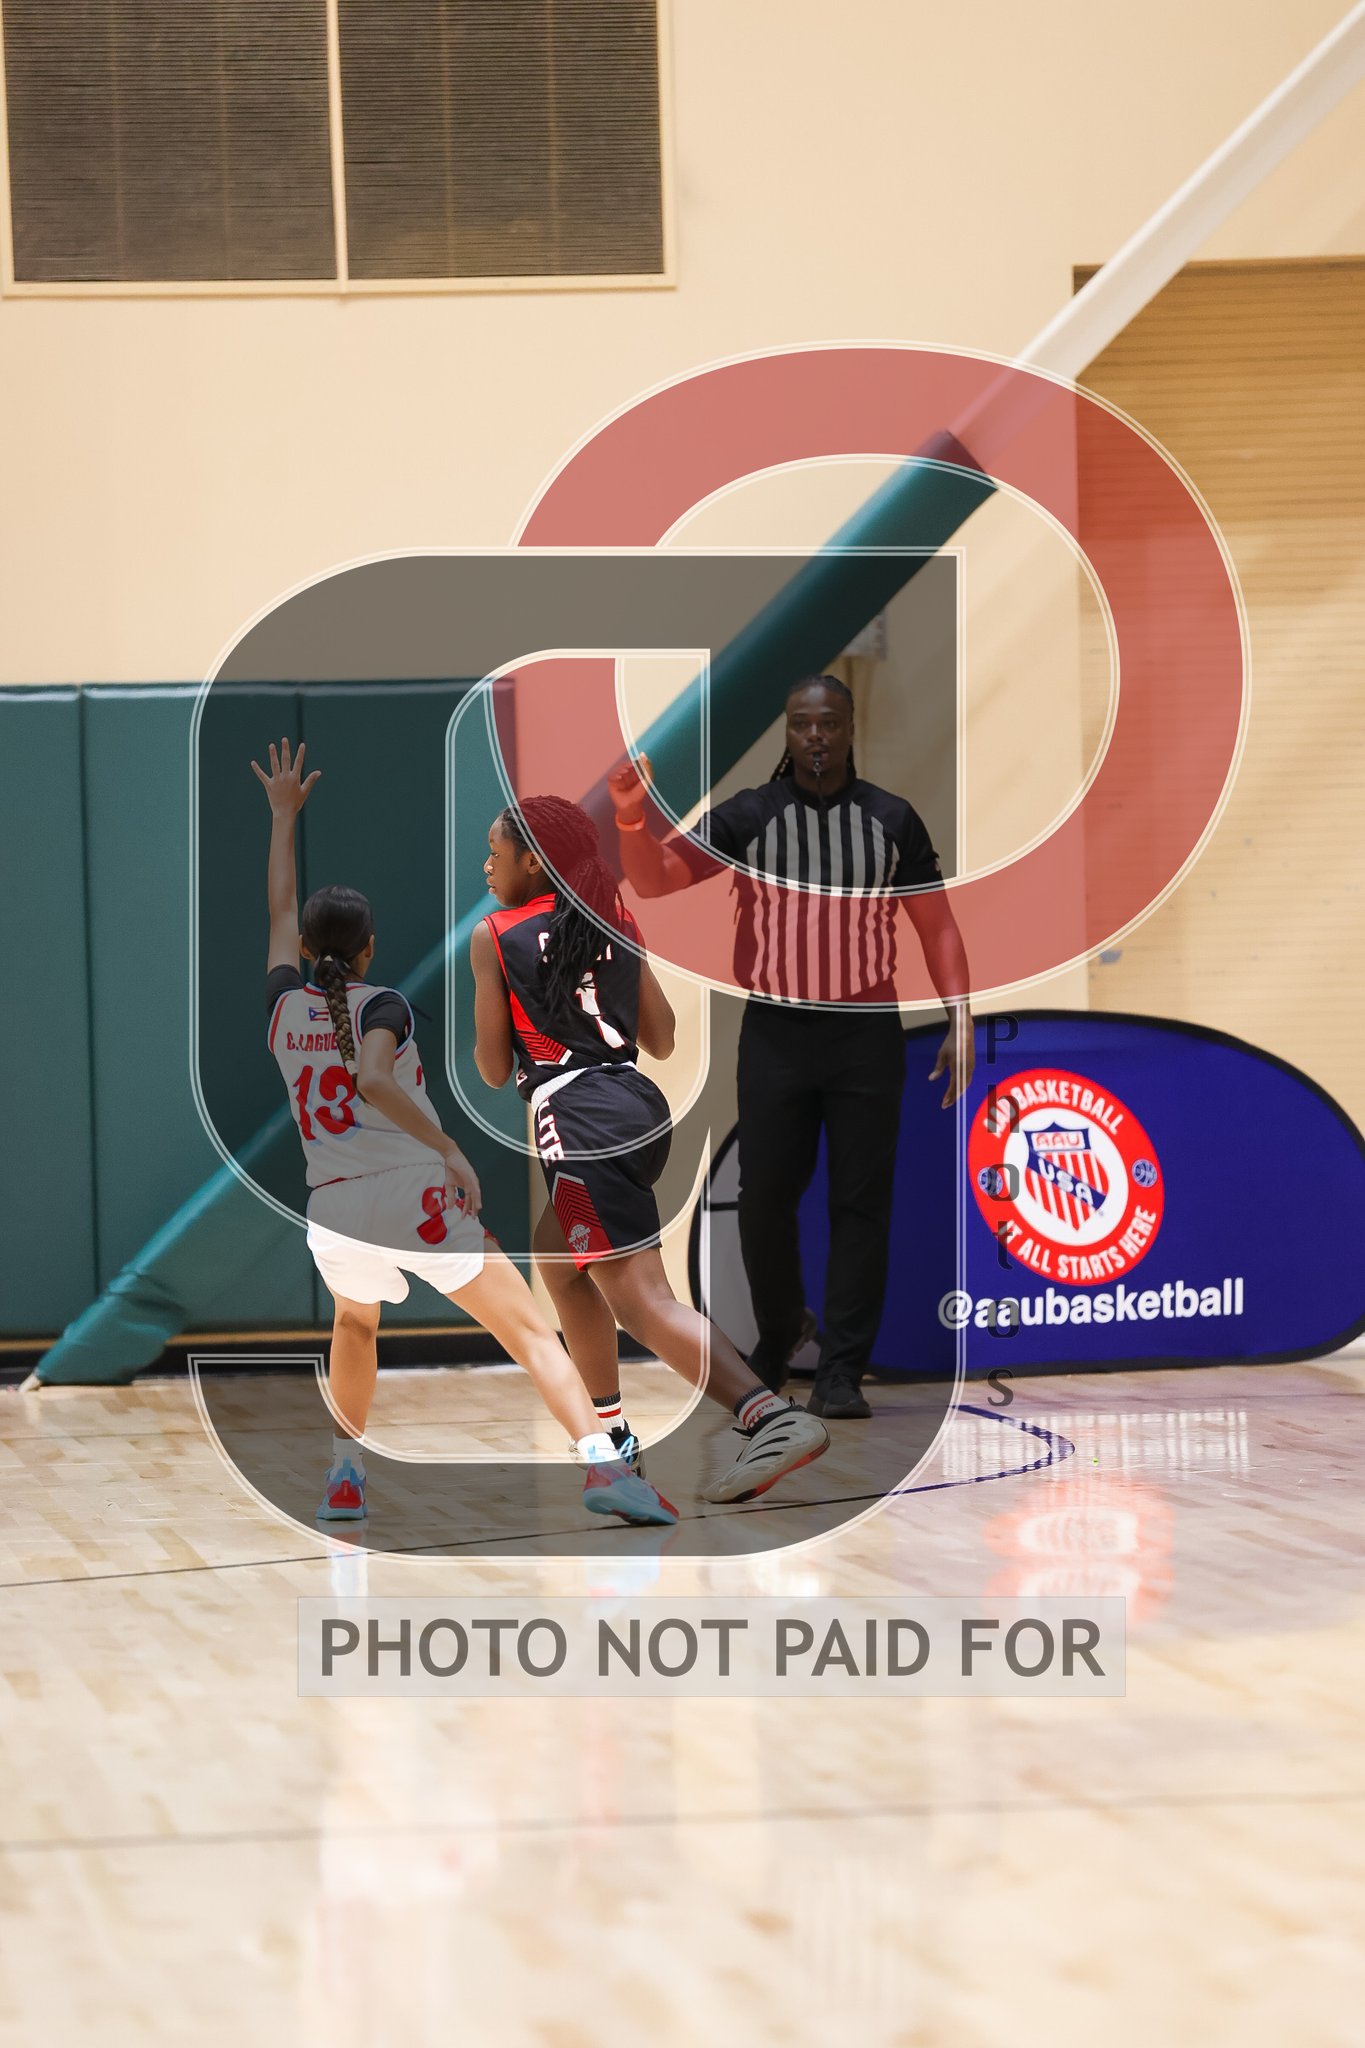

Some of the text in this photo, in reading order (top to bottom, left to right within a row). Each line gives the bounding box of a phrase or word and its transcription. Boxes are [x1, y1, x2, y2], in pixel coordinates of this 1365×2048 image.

[575, 971, 625, 1049] 1
[292, 1065, 357, 1141] 13
[537, 1098, 565, 1169] LITE
[1010, 1079, 1124, 1136] BASKETBALL
[1035, 1132, 1081, 1147] AAU
[1037, 1157, 1094, 1207] USA
[999, 1205, 1157, 1280] IT ALL STARTS HERE
[938, 1277, 1245, 1330] @aaubasketball
